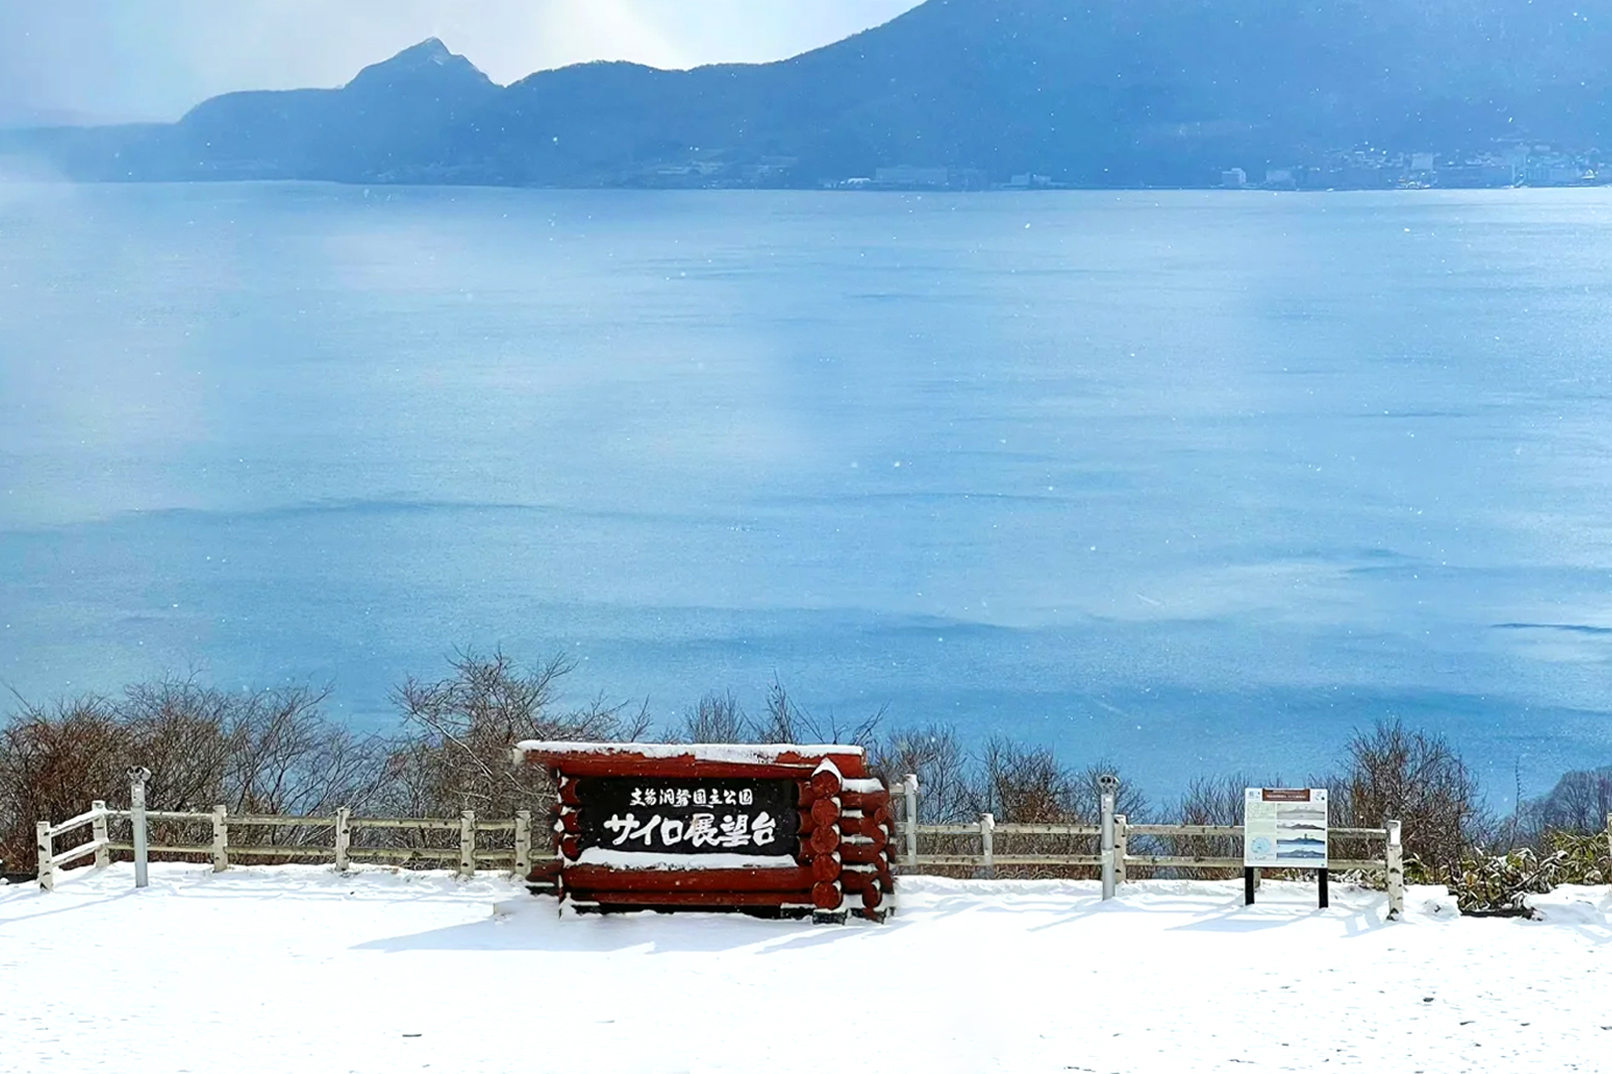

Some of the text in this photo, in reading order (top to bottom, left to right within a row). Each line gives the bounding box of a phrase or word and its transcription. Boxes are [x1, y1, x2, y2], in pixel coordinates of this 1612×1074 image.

[604, 811, 777, 847] サイロ展望台
